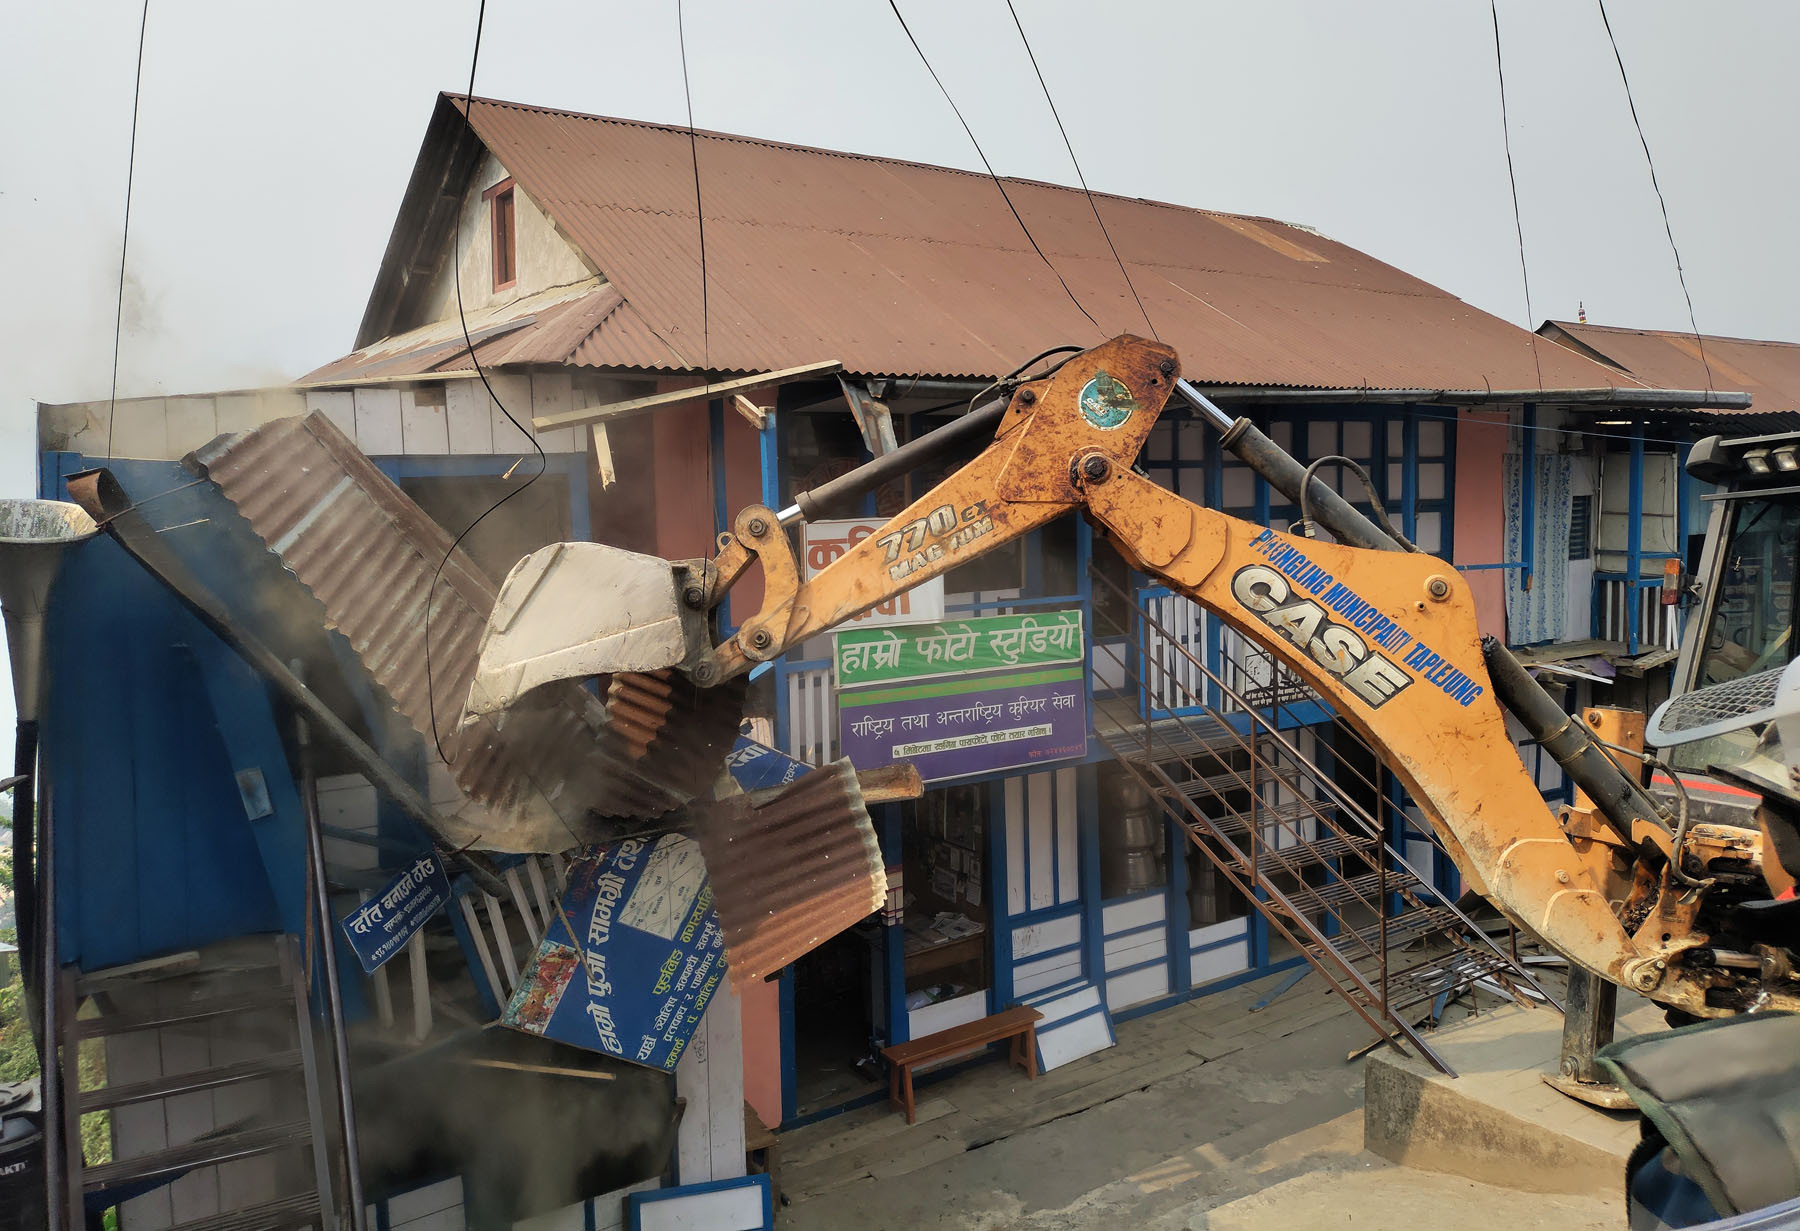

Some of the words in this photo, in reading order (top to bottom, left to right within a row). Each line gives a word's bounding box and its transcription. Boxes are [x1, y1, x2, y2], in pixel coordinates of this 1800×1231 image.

[876, 504, 958, 564] 770
[961, 499, 989, 522] EX
[841, 630, 907, 674] हाम्रो
[916, 624, 982, 664] फोटो
[988, 616, 1078, 664] स्टुडियो
[1230, 564, 1414, 710] CASE
[1320, 582, 1412, 654] MUNICIPALITY
[1402, 642, 1484, 708] TAPLEJUNG
[850, 717, 894, 740] राष्ट्रिय
[900, 712, 930, 731] तथा
[1052, 692, 1075, 708] सेवा
[350, 904, 384, 934] दाँत
[382, 871, 416, 910] बनाउने
[588, 871, 626, 946] सामग्री
[680, 883, 714, 944] नगरपालि
[586, 949, 612, 996] पूजा
[586, 998, 624, 1055] हाम्रो
